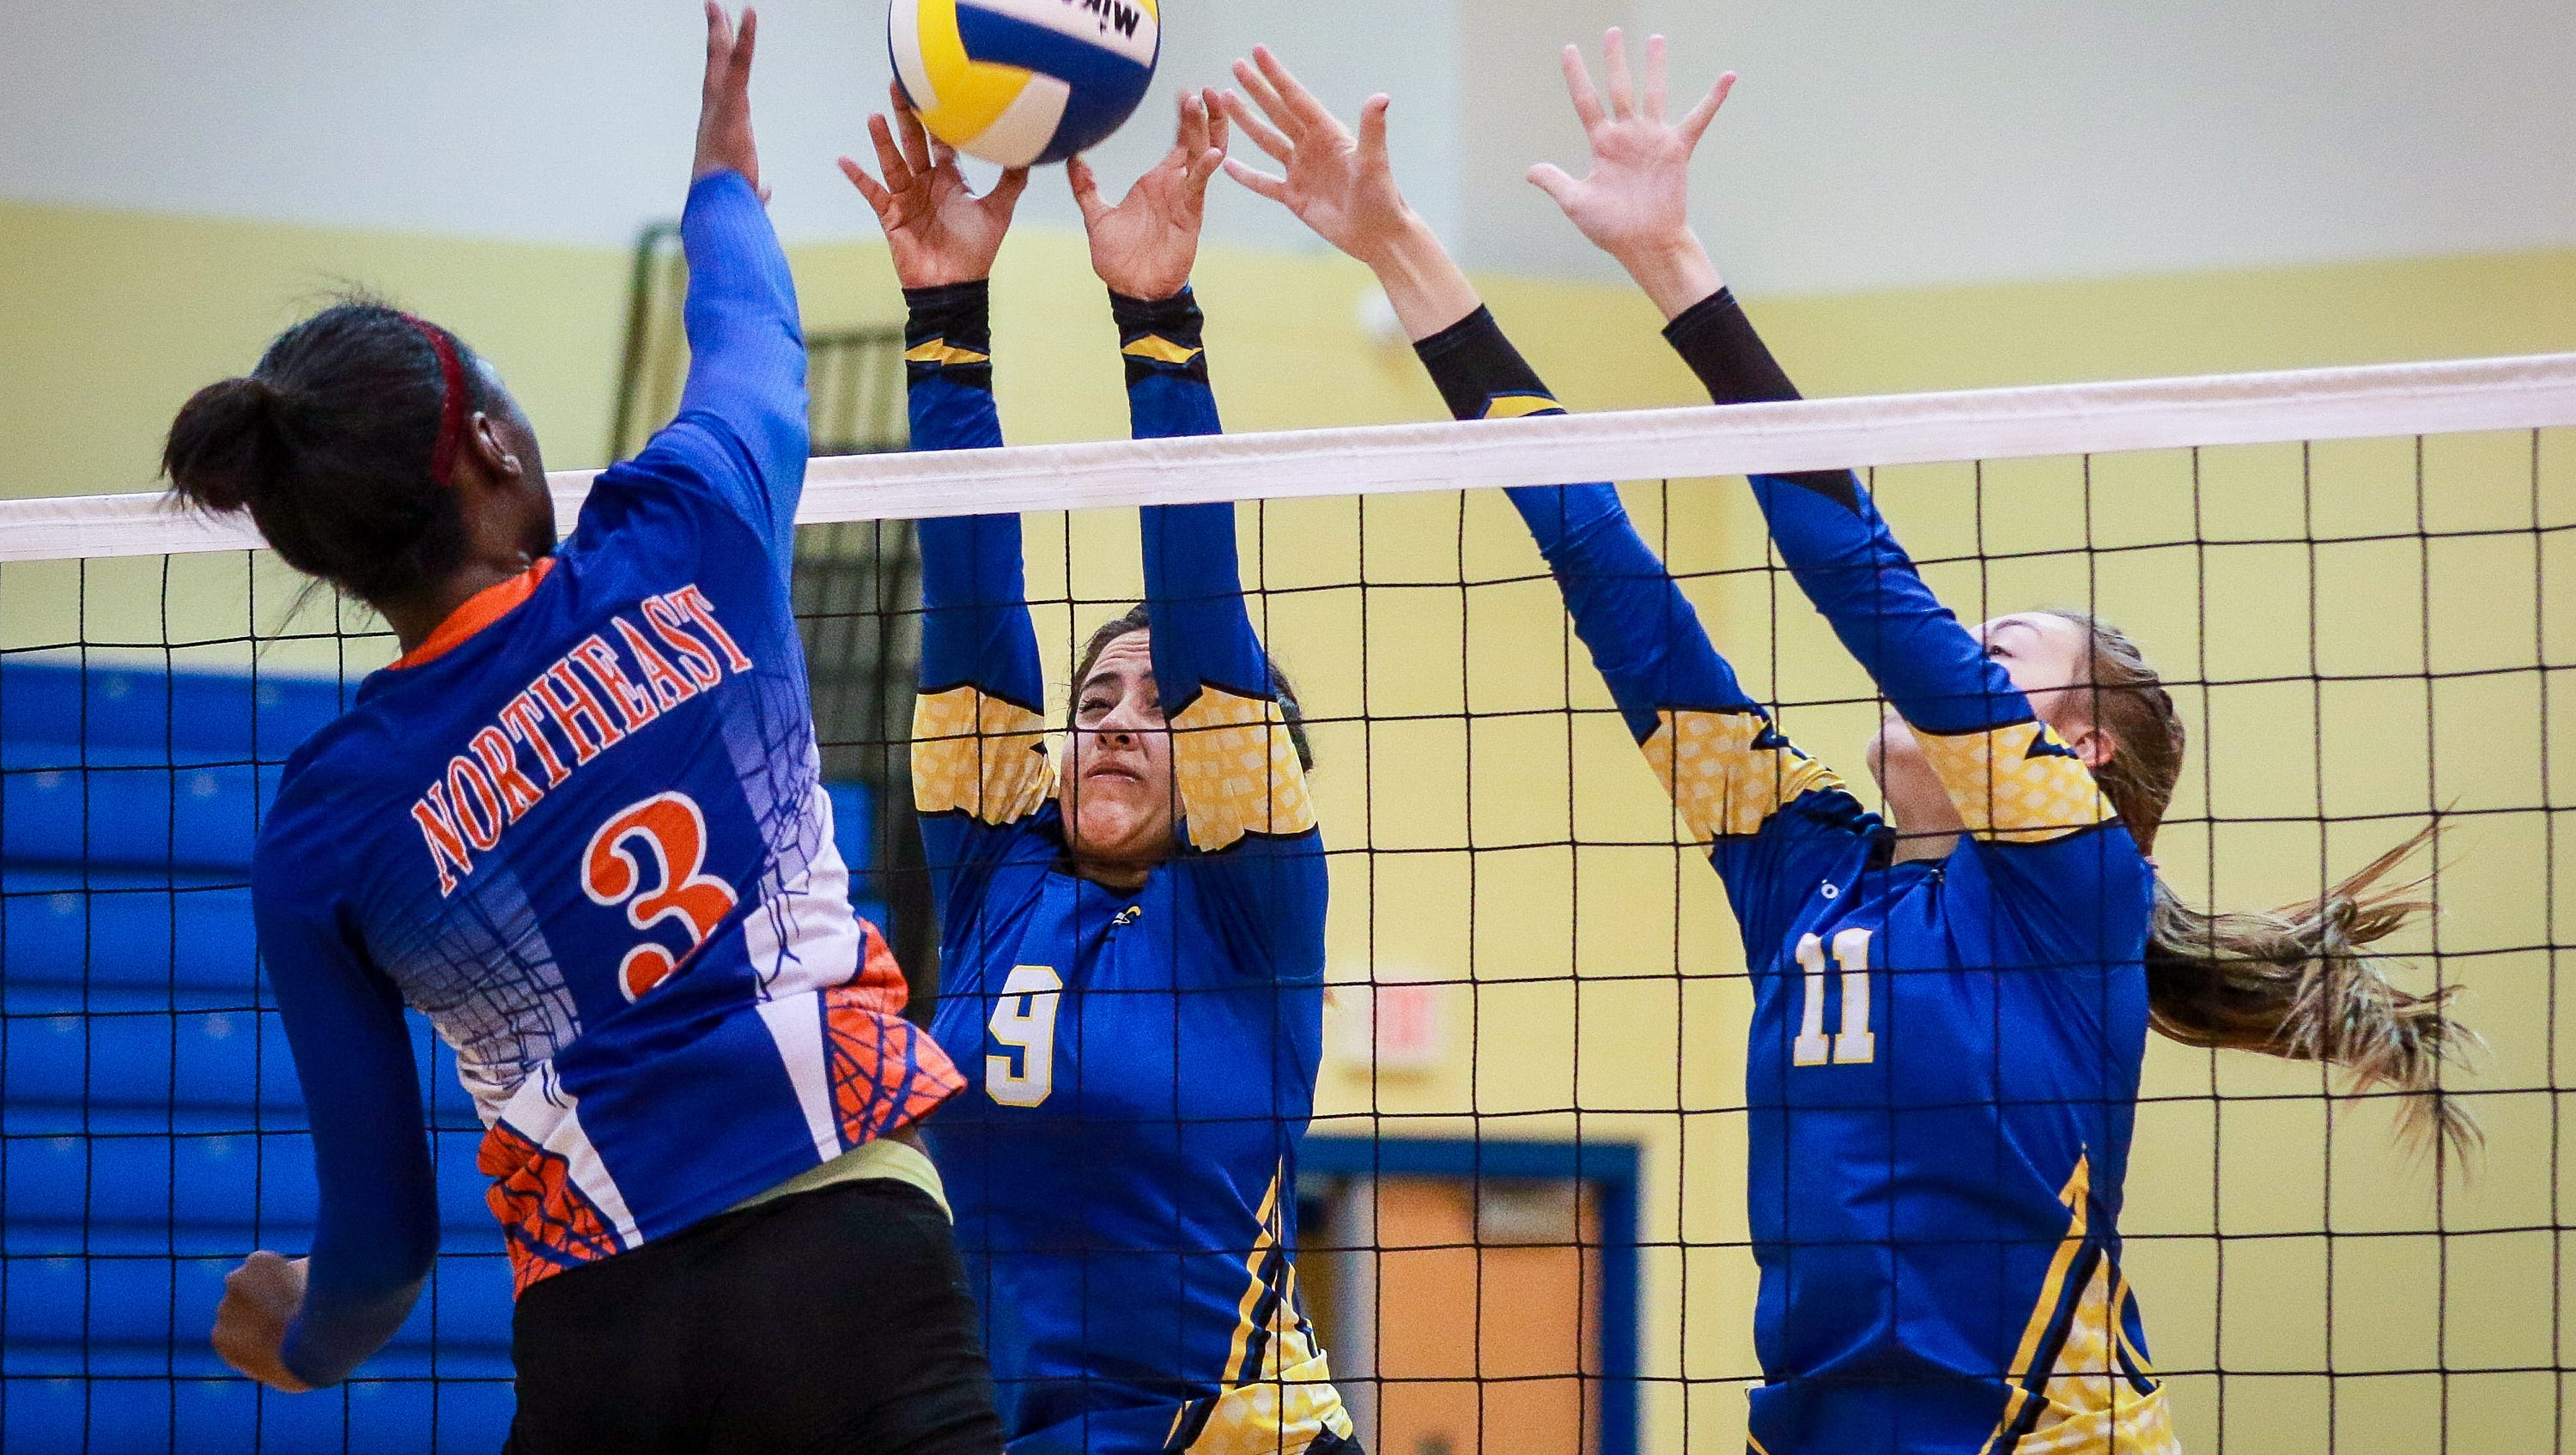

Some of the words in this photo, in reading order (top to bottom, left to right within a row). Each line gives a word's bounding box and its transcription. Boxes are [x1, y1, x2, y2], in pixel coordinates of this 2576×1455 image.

[411, 583, 754, 899] NORTHEAST
[581, 791, 739, 1003] 3
[985, 964, 1064, 1108] 9
[1794, 927, 1875, 1067] 11
